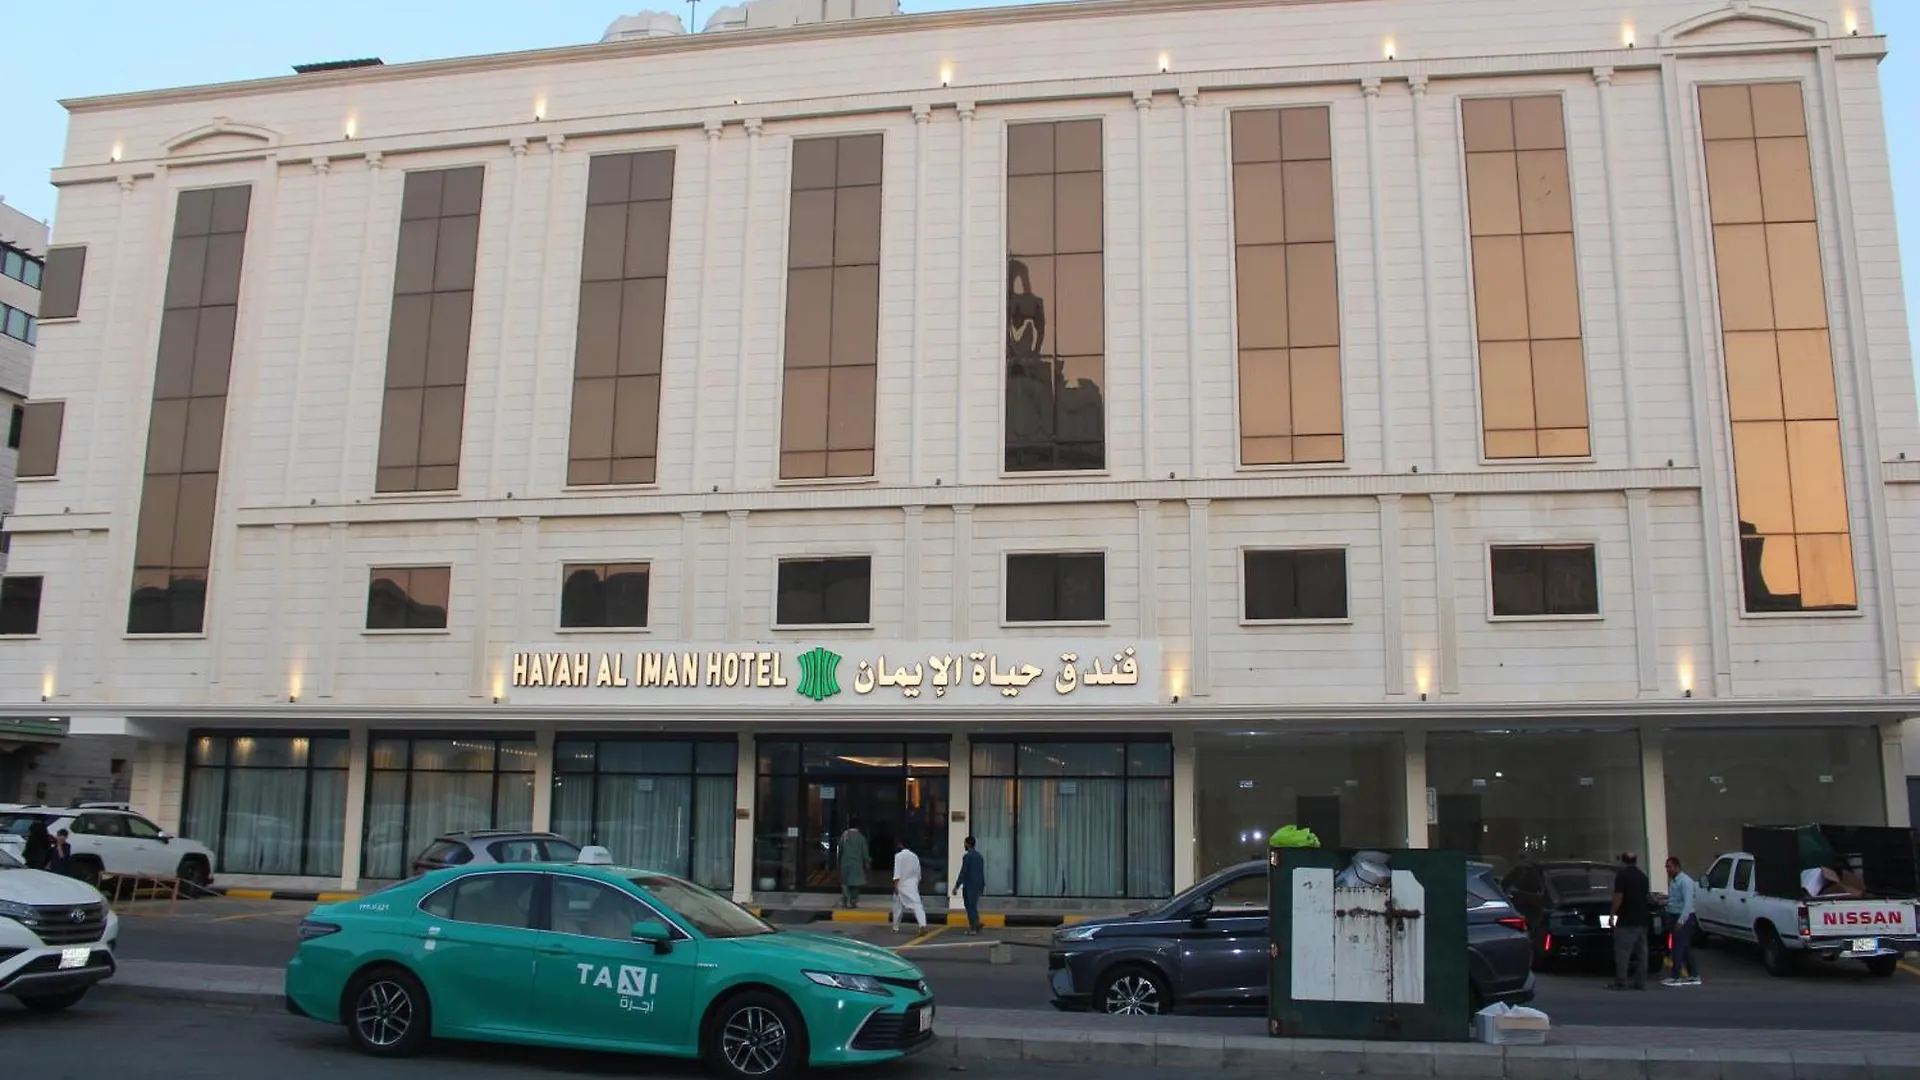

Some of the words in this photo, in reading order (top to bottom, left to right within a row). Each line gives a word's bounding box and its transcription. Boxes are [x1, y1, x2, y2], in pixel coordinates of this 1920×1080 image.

[512, 652, 590, 687] HAYAH
[596, 652, 628, 687] AL
[635, 652, 699, 687] IMAN
[706, 651, 788, 687] HOTEL
[854, 653, 964, 698] الإيمان
[969, 651, 1044, 697] حياة
[1054, 646, 1139, 695] فندق
[1823, 911, 1902, 925] NISSAN
[577, 963, 658, 997] TAXI
